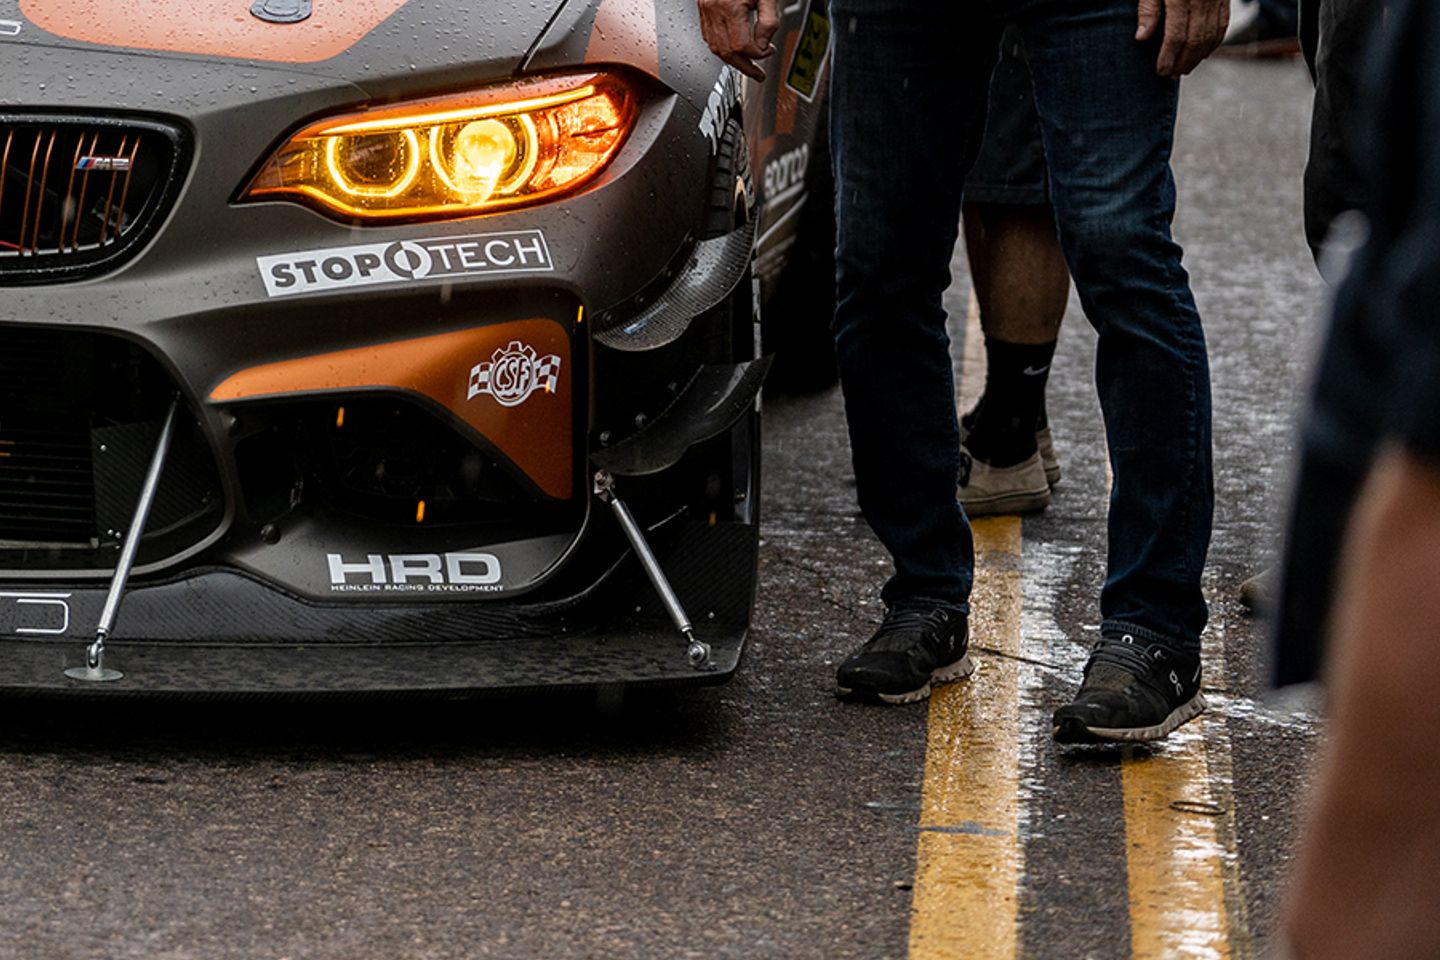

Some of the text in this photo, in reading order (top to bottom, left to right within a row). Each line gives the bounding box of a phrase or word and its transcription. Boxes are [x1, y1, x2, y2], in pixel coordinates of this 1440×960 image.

[493, 357, 530, 393] CSF
[326, 552, 502, 584] HRD
[330, 583, 505, 593] HEINLEIN RACING DEVELOPMENT
